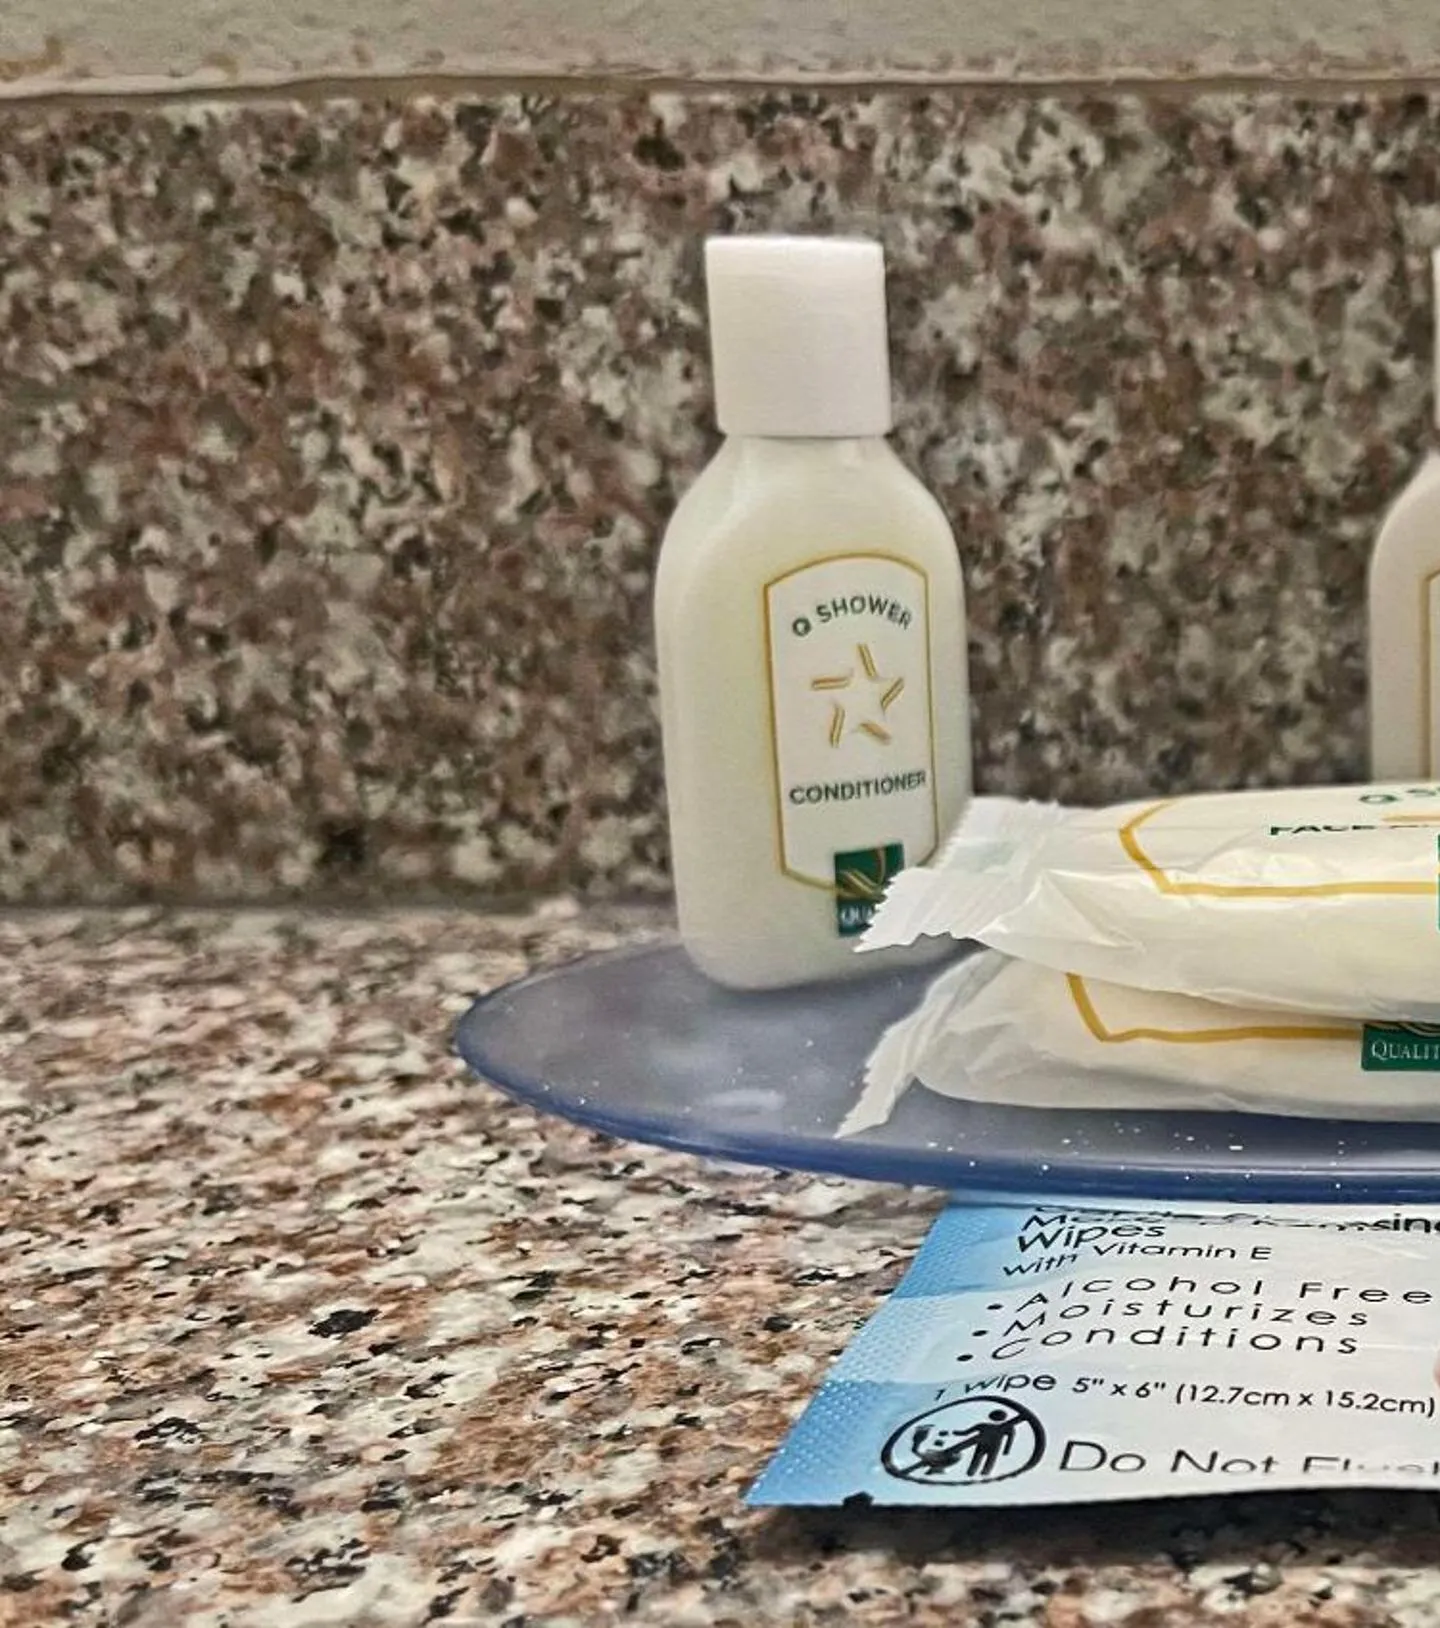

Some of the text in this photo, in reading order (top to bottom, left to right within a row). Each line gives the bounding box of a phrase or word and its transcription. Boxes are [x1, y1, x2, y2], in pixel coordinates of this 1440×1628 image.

[816, 591, 913, 630] SHOWER
[789, 770, 926, 805] CONDITIONER
[1017, 1223, 1166, 1252] Wipes
[1003, 1243, 1272, 1276] with Vitamin E
[1016, 1277, 1432, 1312] Alcohol Free
[1003, 1299, 1367, 1337] Moisturizes
[992, 1326, 1358, 1359] Conditions
[964, 1373, 1056, 1394] wipe
[1072, 1377, 1104, 1393] 5"
[1110, 1383, 1127, 1396] x
[1135, 1381, 1167, 1398] 6"
[1176, 1384, 1289, 1406] (12.7cm
[1298, 1393, 1313, 1406] x
[1326, 1390, 1435, 1418] 15.2cm)
[1060, 1440, 1146, 1472] Do
[1170, 1448, 1278, 1474] Not
